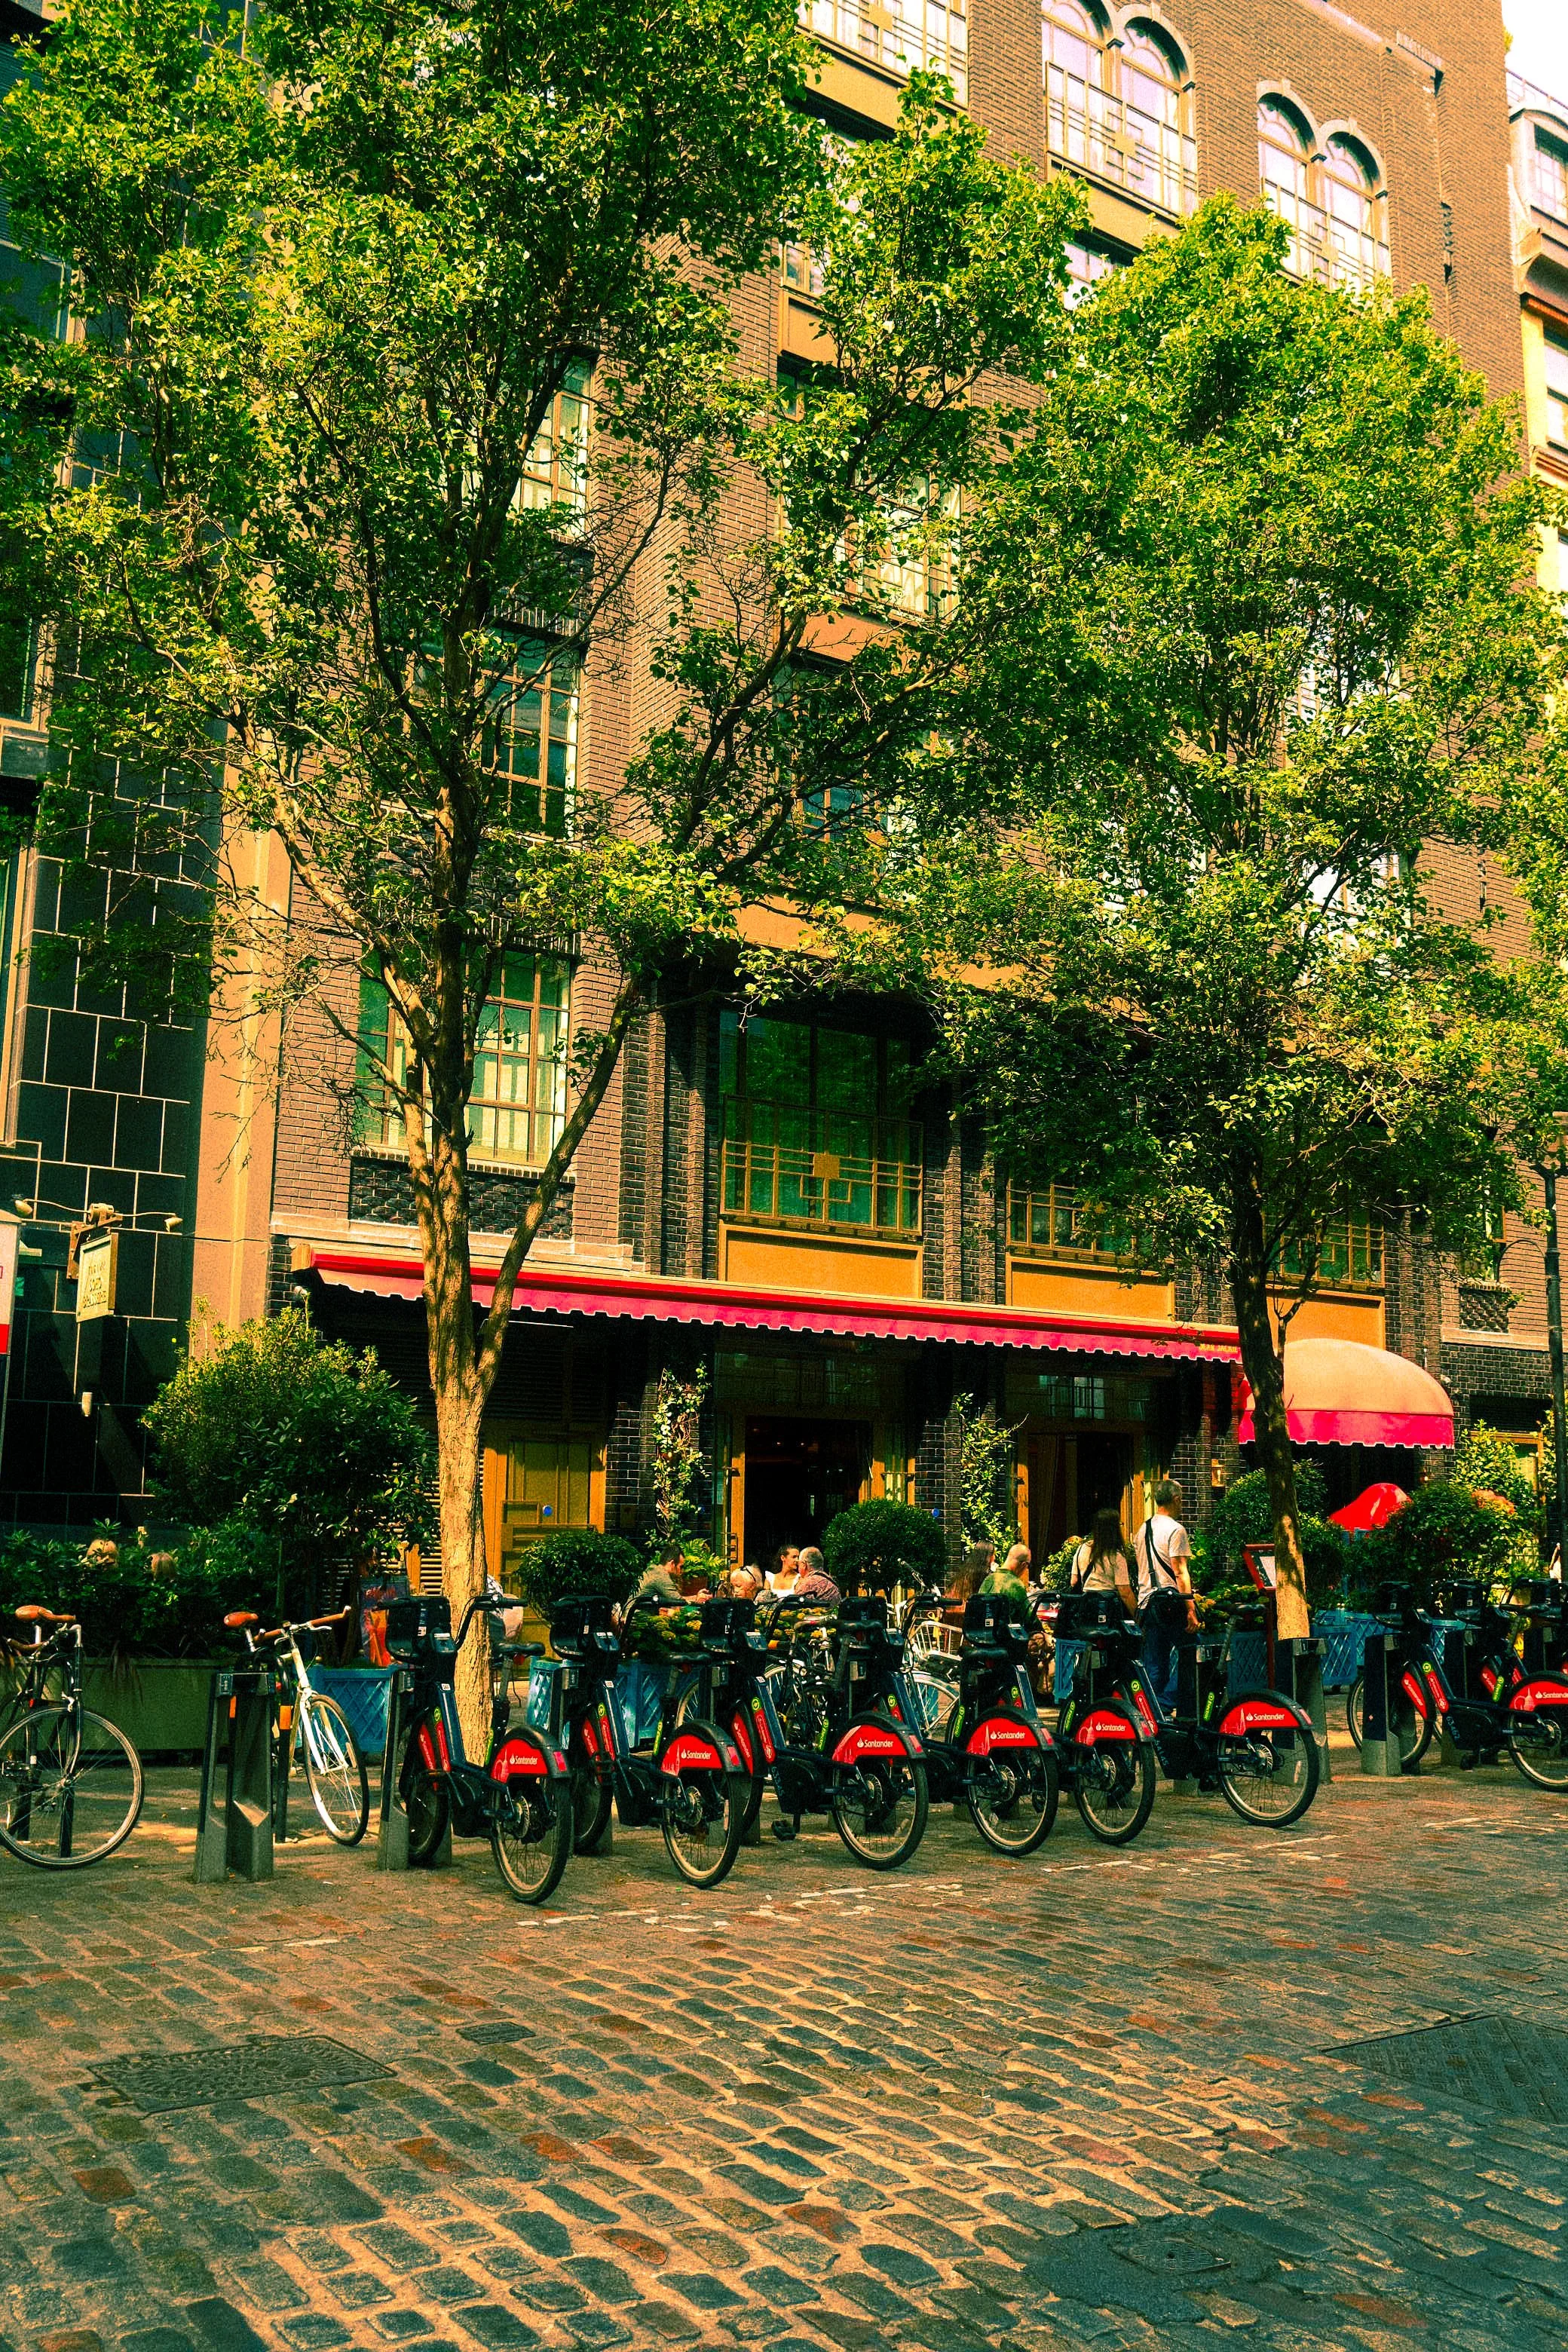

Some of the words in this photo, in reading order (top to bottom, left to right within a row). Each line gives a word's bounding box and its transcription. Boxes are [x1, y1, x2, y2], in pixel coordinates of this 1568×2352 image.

[1253, 1713, 1285, 1721] Santander
[1101, 1723, 1125, 1732] Santander
[997, 1731, 1026, 1739] Santander
[864, 1739, 894, 1747] Santander
[686, 1750, 712, 1759] Santander
[514, 1756, 538, 1766] Santander
